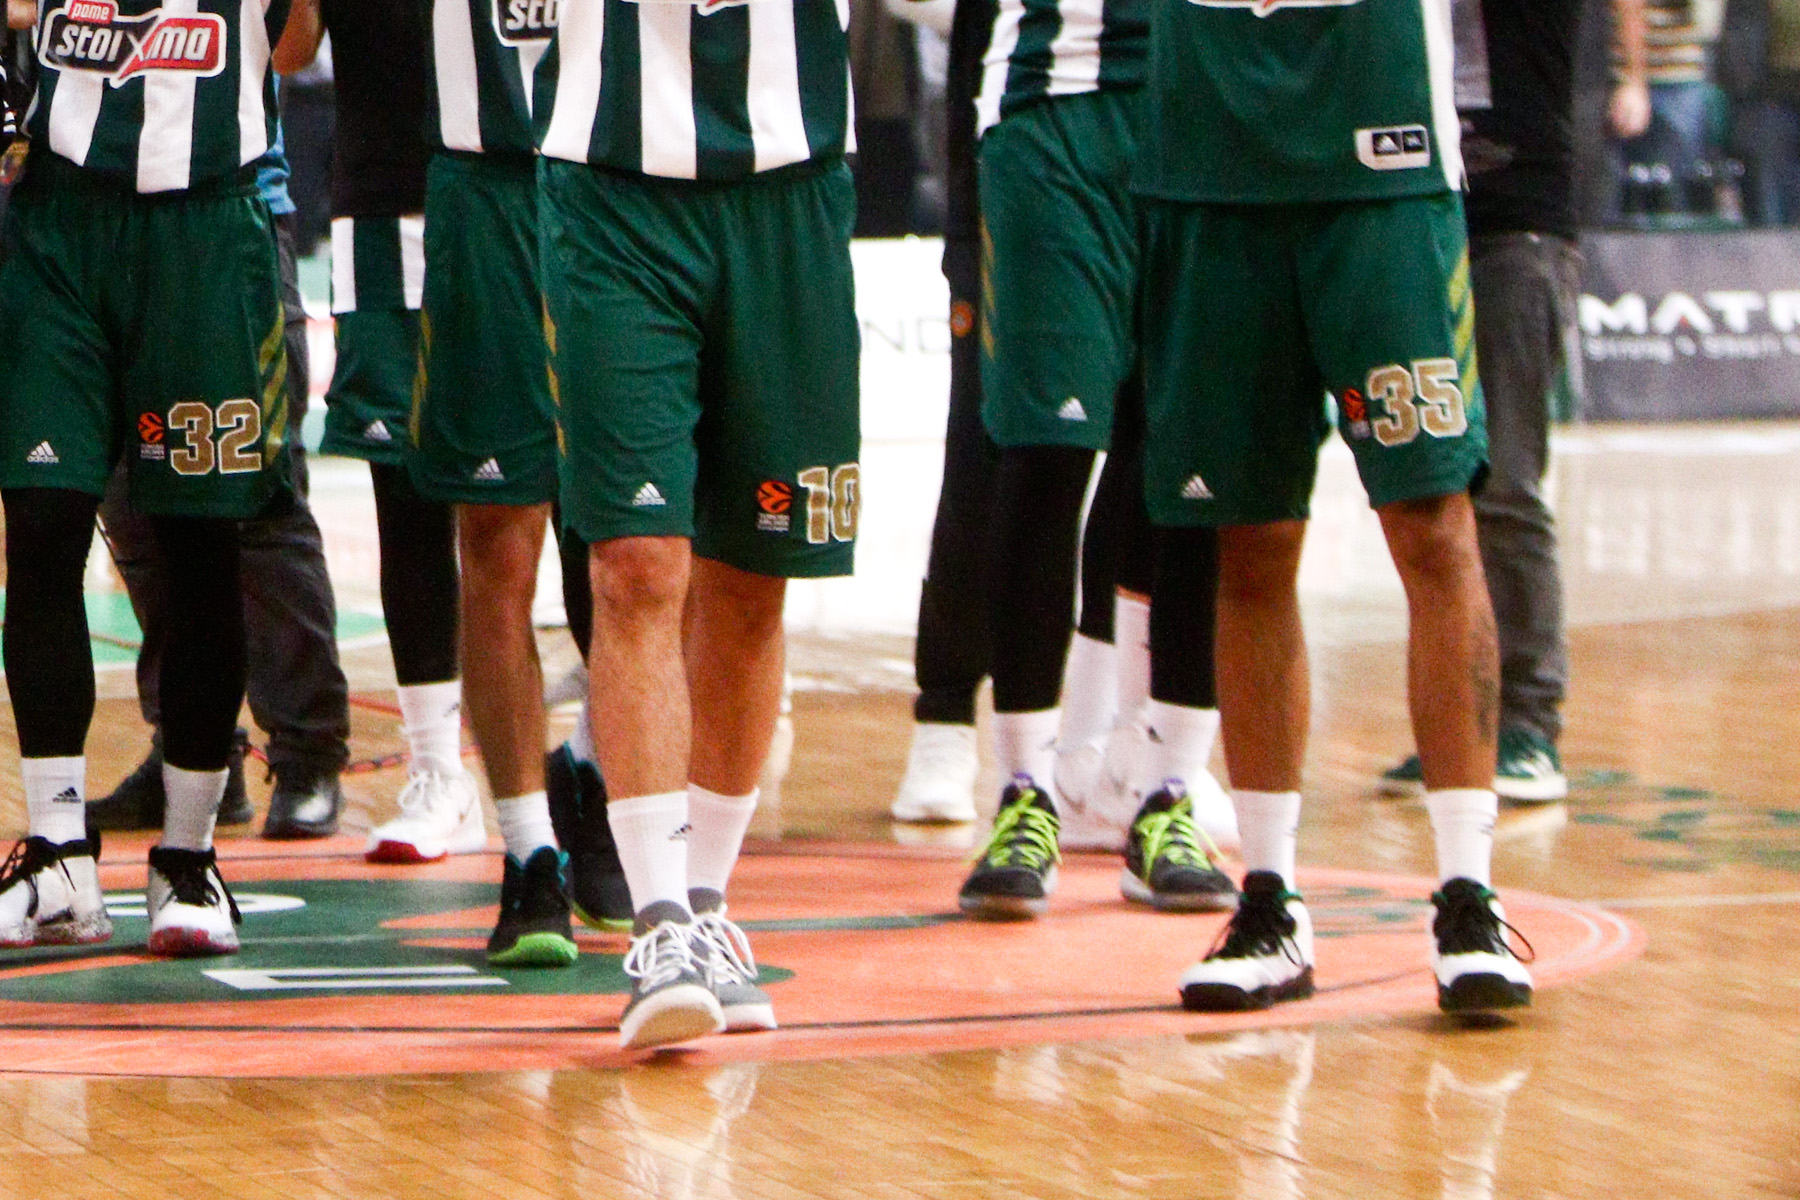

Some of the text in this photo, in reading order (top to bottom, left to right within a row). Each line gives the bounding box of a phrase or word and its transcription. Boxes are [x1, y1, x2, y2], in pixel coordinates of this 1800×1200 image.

[71, 2, 110, 21] pame
[168, 398, 262, 476] 32
[1367, 356, 1468, 448] 35
[798, 462, 861, 545] 10
